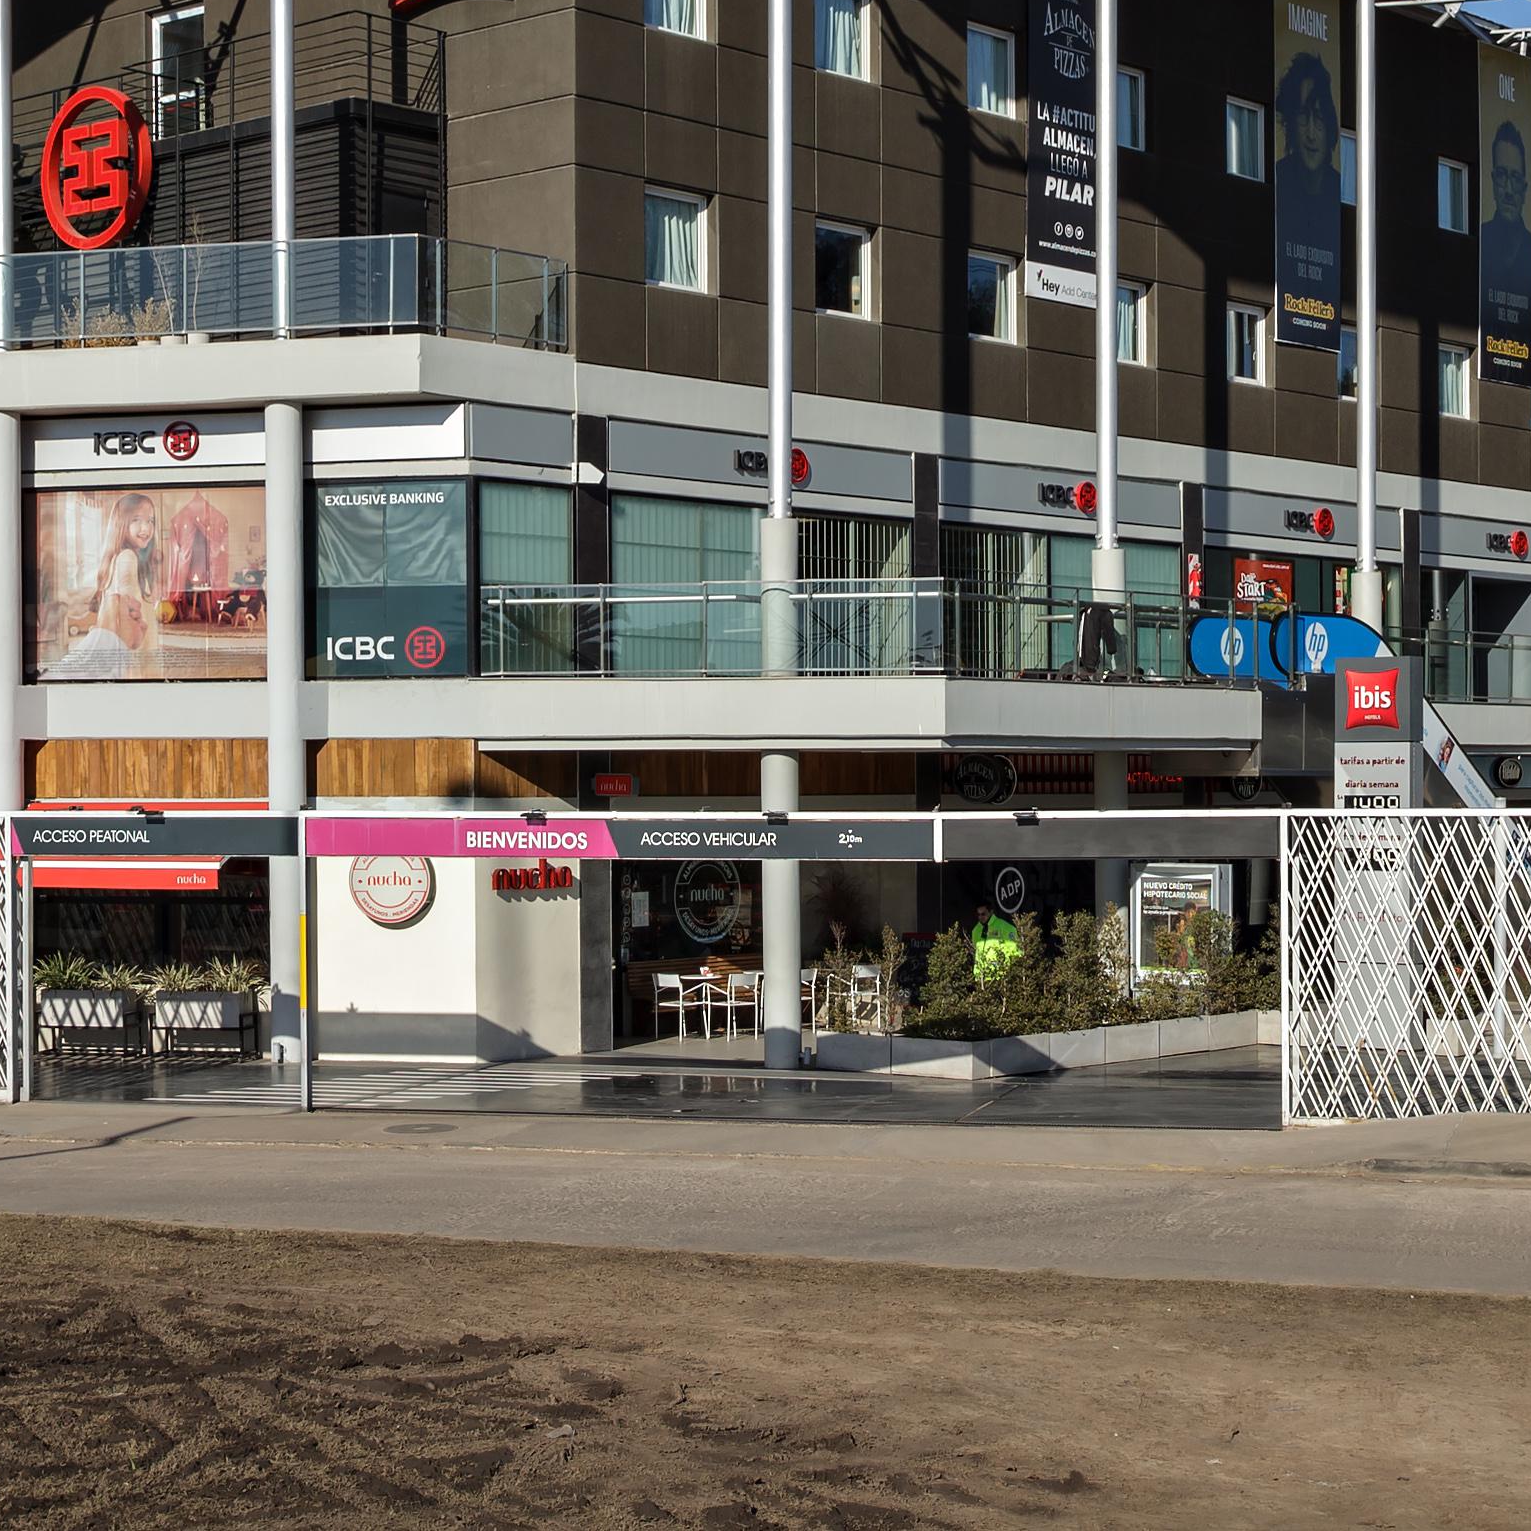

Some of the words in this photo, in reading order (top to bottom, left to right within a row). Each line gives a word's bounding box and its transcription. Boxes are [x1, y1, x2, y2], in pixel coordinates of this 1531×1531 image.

[1288, 2, 1328, 43] IMAGINE
[1054, 47, 1086, 79] PIZZAS
[1499, 73, 1516, 103] ONE
[1037, 101, 1050, 122] LA
[1052, 104, 1096, 133] #ACTITU
[1050, 152, 1080, 178] LLEGÓ
[1082, 160, 1089, 179] A
[1045, 175, 1095, 207] PILAR
[1042, 277, 1060, 296] Hey
[93, 430, 156, 456] ICBC
[733, 449, 768, 473] ICB
[324, 493, 387, 507] EXCLUSIVE
[389, 492, 445, 504] BANKING
[1038, 482, 1075, 506] ICBC
[326, 636, 395, 661] ICBC
[1354, 685, 1391, 709] ibis
[1340, 756, 1364, 765] tarifas
[1372, 756, 1394, 768] partir
[1396, 756, 1405, 765] de
[1345, 779, 1367, 789] diaria
[1369, 781, 1399, 789] semana
[33, 830, 86, 843] ACCESO
[89, 830, 150, 843] PEATONAL
[466, 831, 588, 849] BIENVENIDOS
[640, 832, 700, 846] ACCESO
[703, 832, 777, 847] VEHICULAR
[177, 873, 207, 885] nucha
[367, 871, 411, 886] nucha
[492, 858, 573, 890] nucha
[690, 883, 725, 902] nucha
[1000, 879, 1021, 901] ADP
